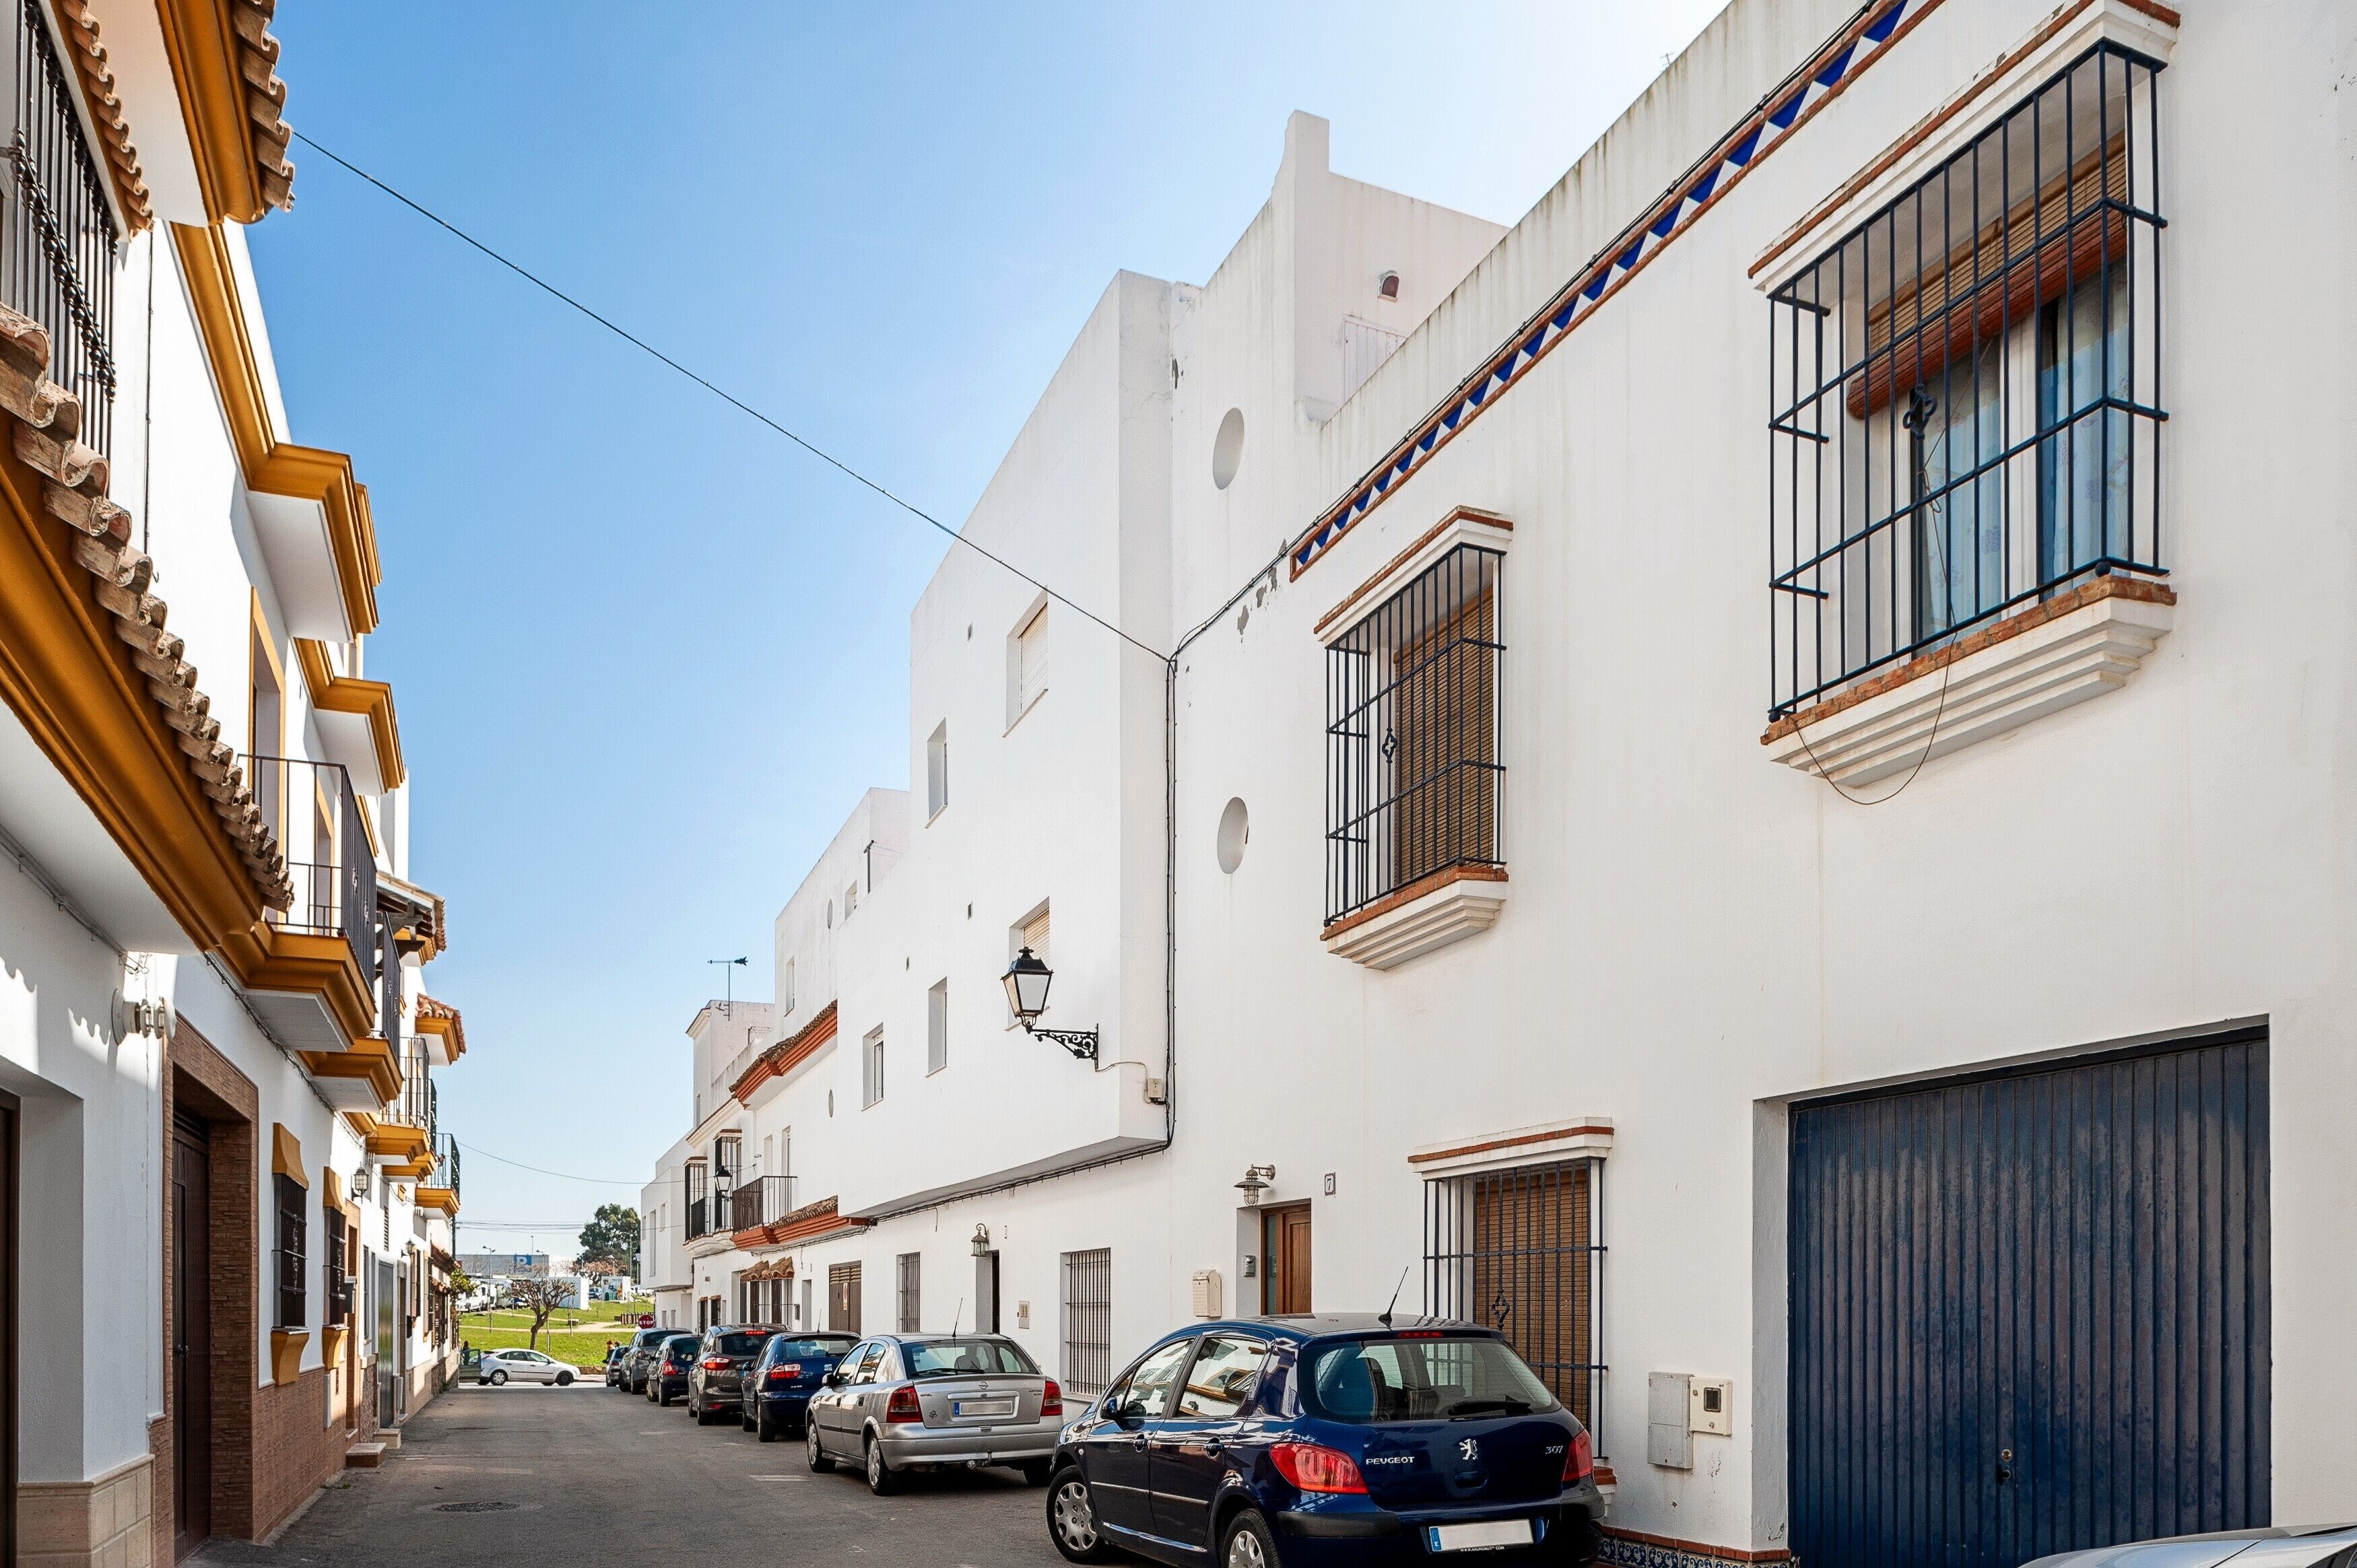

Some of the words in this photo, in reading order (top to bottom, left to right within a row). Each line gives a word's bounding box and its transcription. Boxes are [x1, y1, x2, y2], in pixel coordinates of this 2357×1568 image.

[1327, 1178, 1332, 1191] 7
[1545, 1445, 1564, 1455] 307
[1366, 1456, 1415, 1465] PEUGEOT
